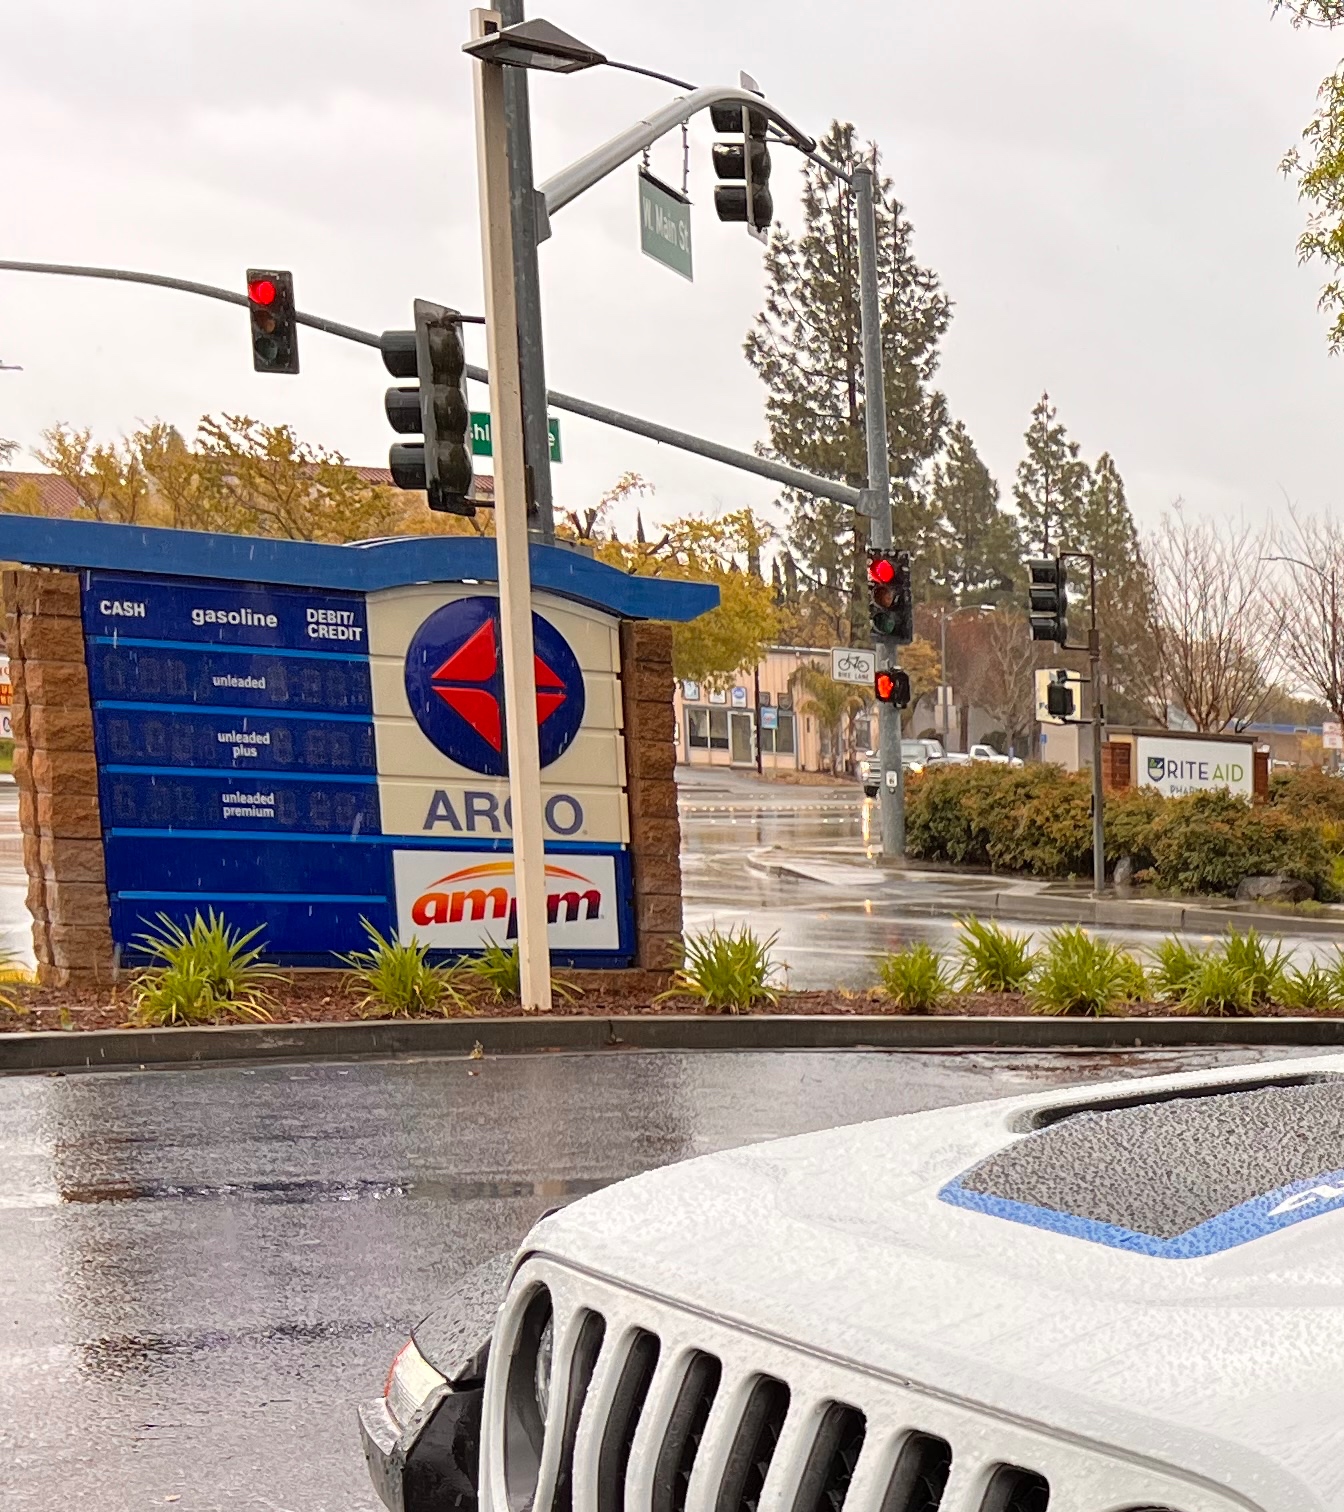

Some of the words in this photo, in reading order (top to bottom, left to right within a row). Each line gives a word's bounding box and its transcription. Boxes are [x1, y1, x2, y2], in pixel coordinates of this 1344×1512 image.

[655, 203, 677, 246] Main
[678, 219, 690, 254] St
[100, 600, 146, 618] CASH
[192, 608, 278, 628] gasoline
[306, 608, 355, 626] DEBIT/
[307, 624, 363, 641] CREDIT
[212, 675, 266, 690] unleaded
[217, 731, 271, 746] unleaded
[232, 745, 258, 759] plus
[1167, 760, 1210, 781] RITE
[1211, 763, 1244, 783] AID
[222, 791, 275, 805] unleaded
[222, 805, 275, 819] premium
